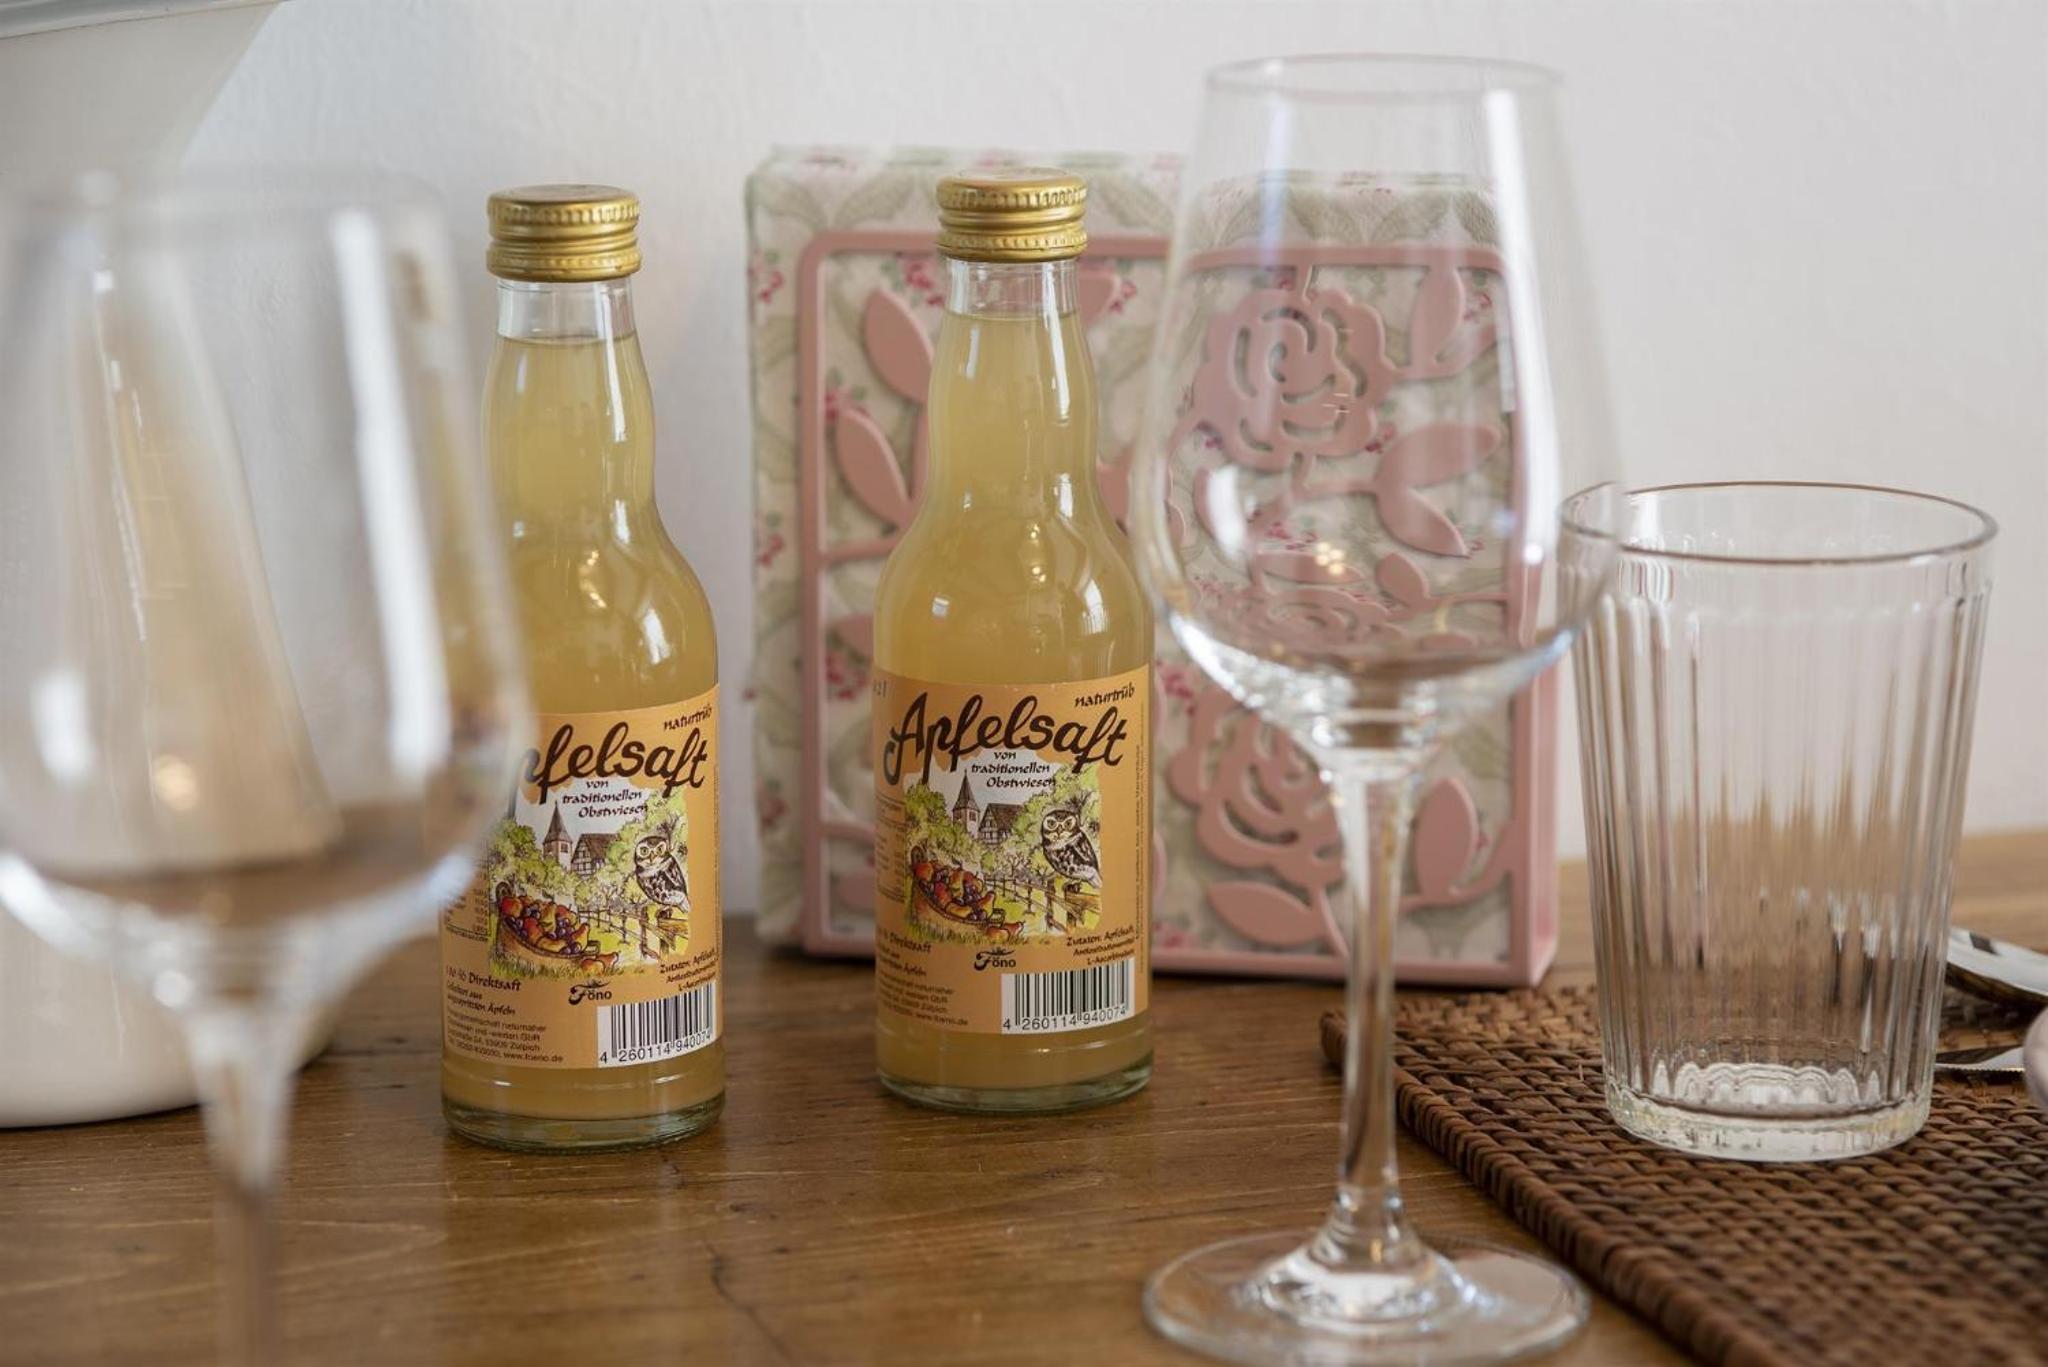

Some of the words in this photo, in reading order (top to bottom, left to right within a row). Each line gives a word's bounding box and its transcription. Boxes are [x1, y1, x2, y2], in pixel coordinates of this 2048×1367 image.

[1074, 682, 1135, 708] naturtrüb
[884, 692, 1128, 786] Apfelsaft
[993, 751, 1017, 760] von
[508, 721, 708, 819] pfelsaft
[971, 762, 1050, 775] traditionellen
[586, 780, 610, 789] von
[986, 776, 1057, 788] Obstwiesen
[562, 790, 643, 804] traditionellen
[578, 804, 649, 817] Obstwiesen
[974, 948, 1016, 971] Föno
[469, 971, 522, 992] Direktsaft
[568, 979, 612, 1006] Föno
[1003, 1018, 1011, 1030] 4
[1022, 1014, 1077, 1031] 260114
[599, 1051, 608, 1063] 4
[618, 1043, 671, 1063] 260114
